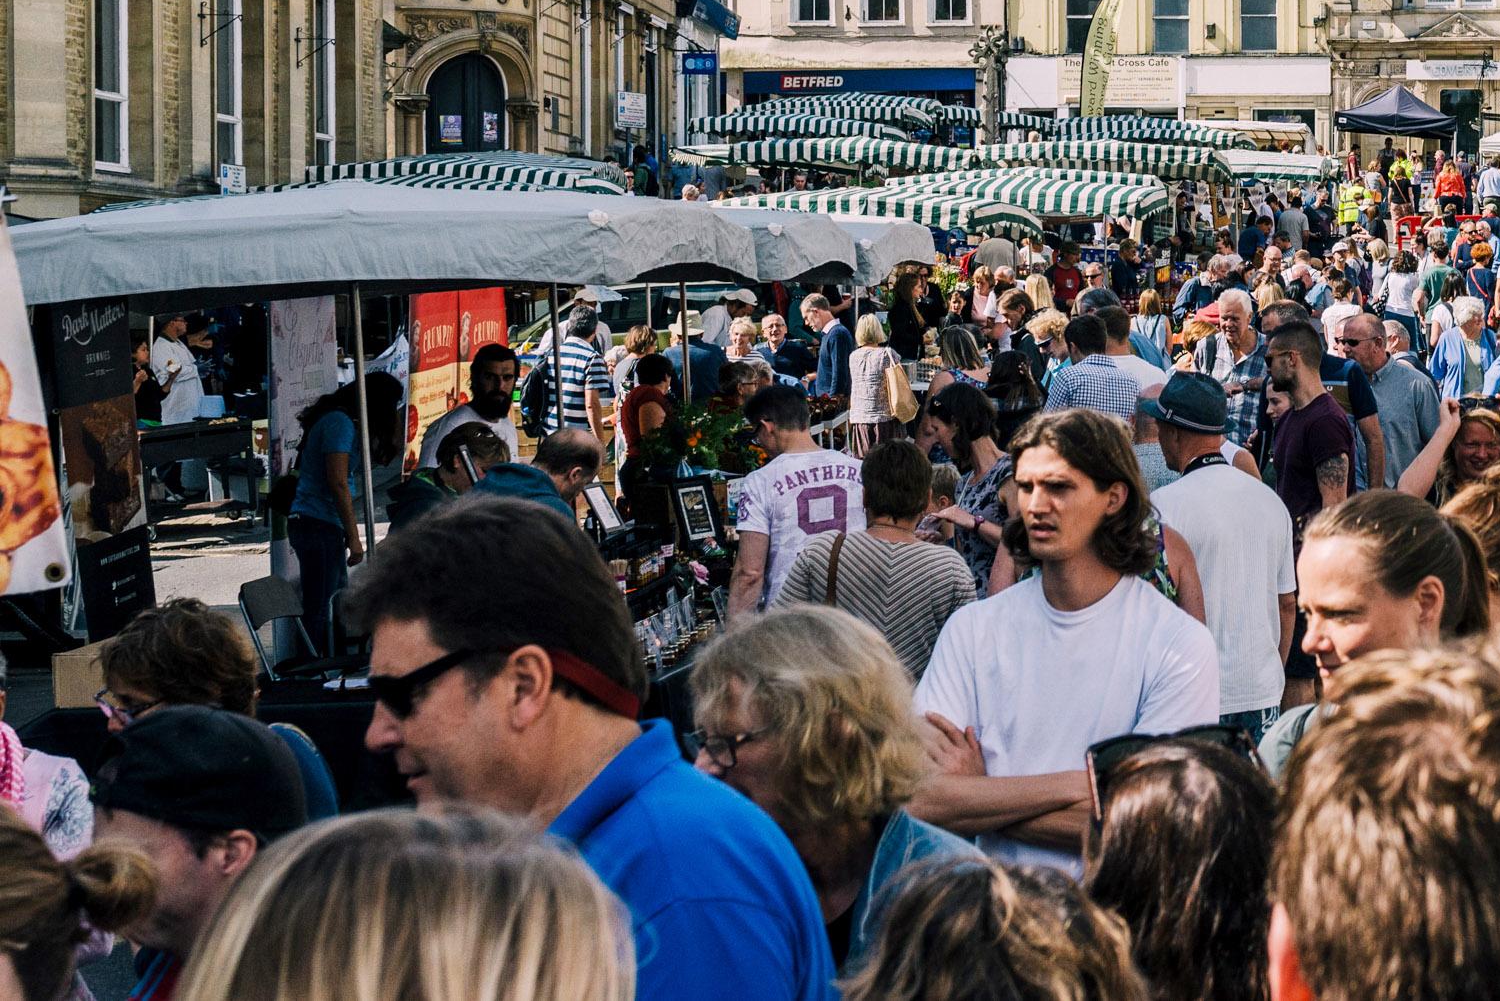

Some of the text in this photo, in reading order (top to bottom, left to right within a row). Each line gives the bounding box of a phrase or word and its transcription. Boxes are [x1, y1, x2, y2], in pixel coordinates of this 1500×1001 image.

[1088, 17, 1108, 79] Winning
[1064, 59, 1081, 67] The
[1117, 58, 1145, 67] Cross
[1148, 58, 1169, 67] Cafe
[1431, 65, 1497, 77] COVENTY
[783, 76, 844, 88] BETFRED
[1087, 81, 1098, 116] ward
[61, 302, 126, 345] Dark Matters
